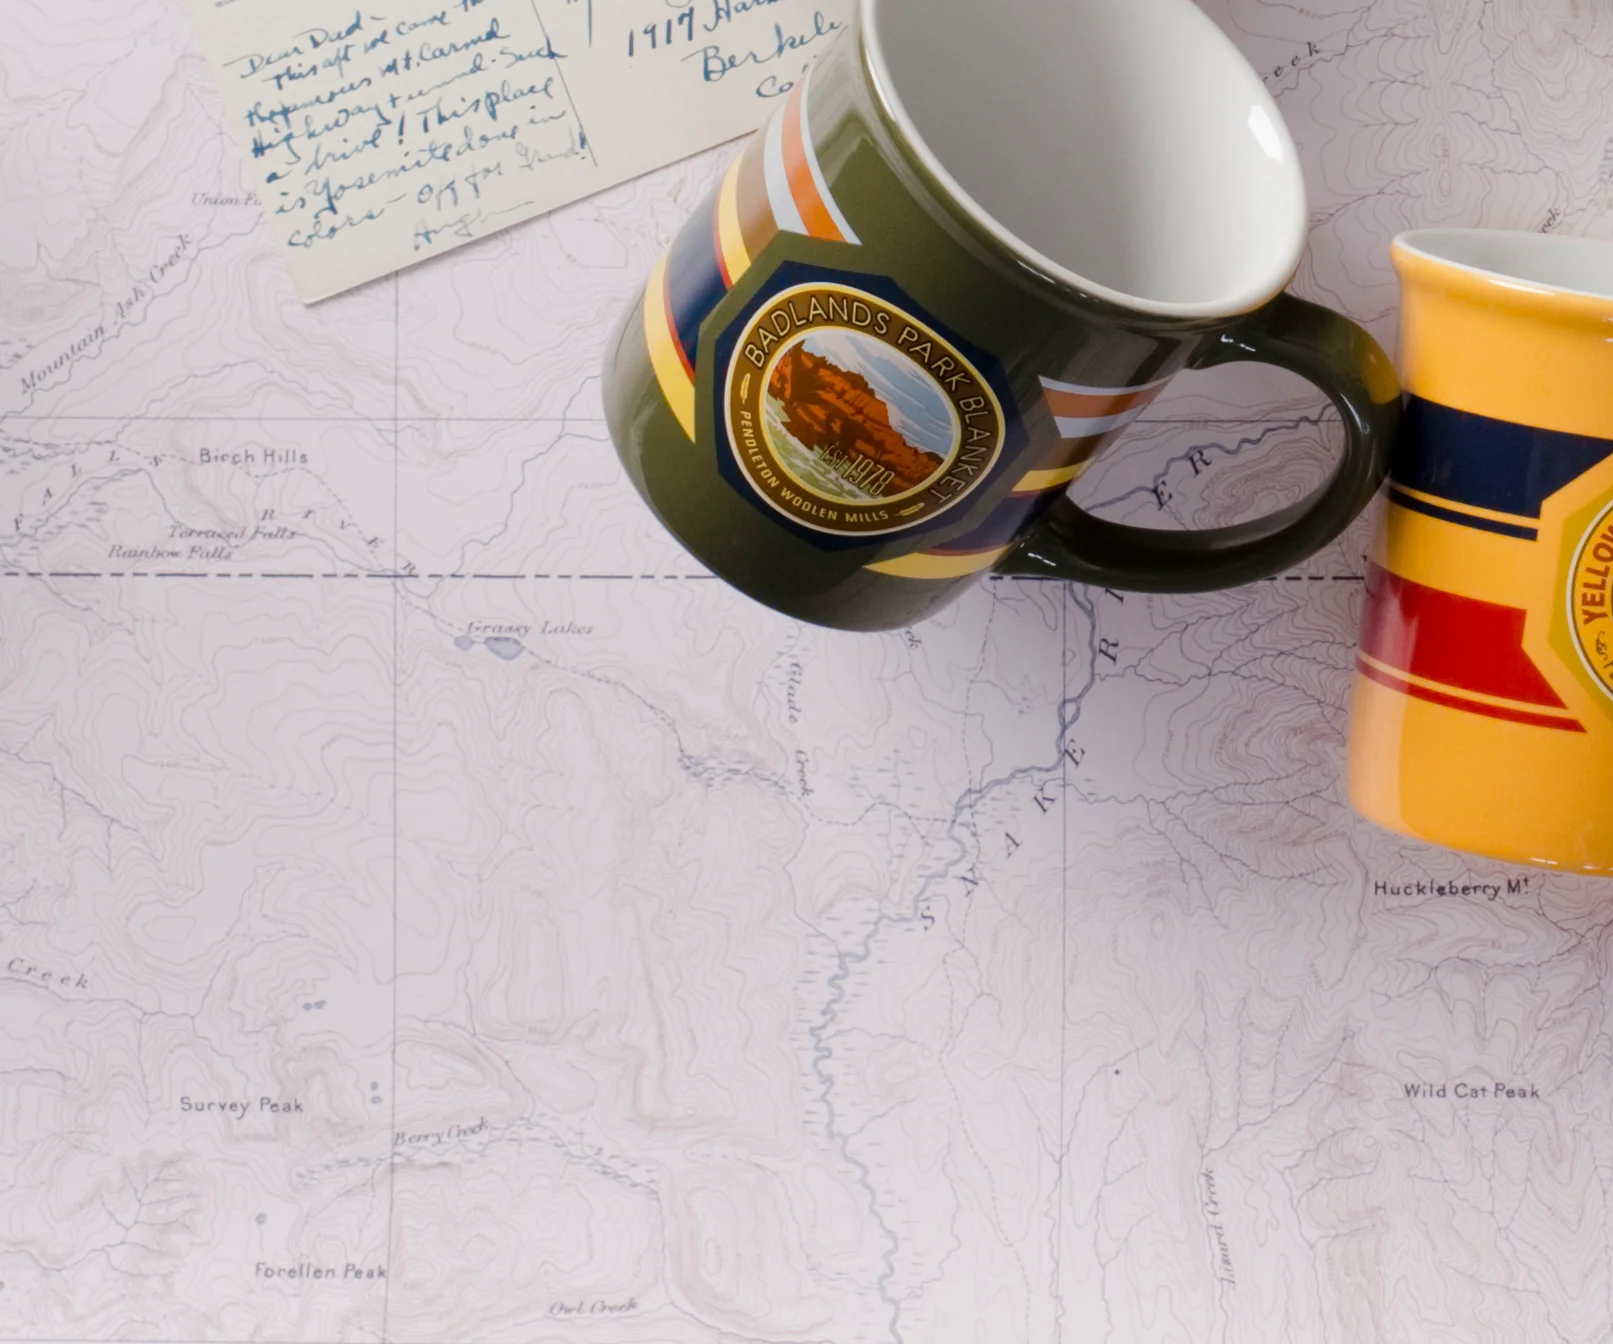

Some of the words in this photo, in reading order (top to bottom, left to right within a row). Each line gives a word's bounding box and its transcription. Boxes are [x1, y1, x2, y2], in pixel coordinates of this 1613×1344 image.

[744, 296, 892, 368] BADLANDS
[898, 325, 972, 393] PARK
[740, 410, 780, 488] PENDLETON
[780, 487, 838, 521] WOOLEN
[845, 510, 889, 523] MILLS
[929, 395, 992, 505] BLANKET
[1374, 880, 1500, 901] Huckleberry
[180, 1097, 250, 1120] Survey
[260, 1097, 304, 1113] Peak
[1404, 1084, 1446, 1098] Wild
[1454, 1083, 1488, 1097] Cat
[1494, 1083, 1539, 1098] Peak
[255, 1262, 335, 1279] Forellen
[344, 1264, 387, 1279] Peak
